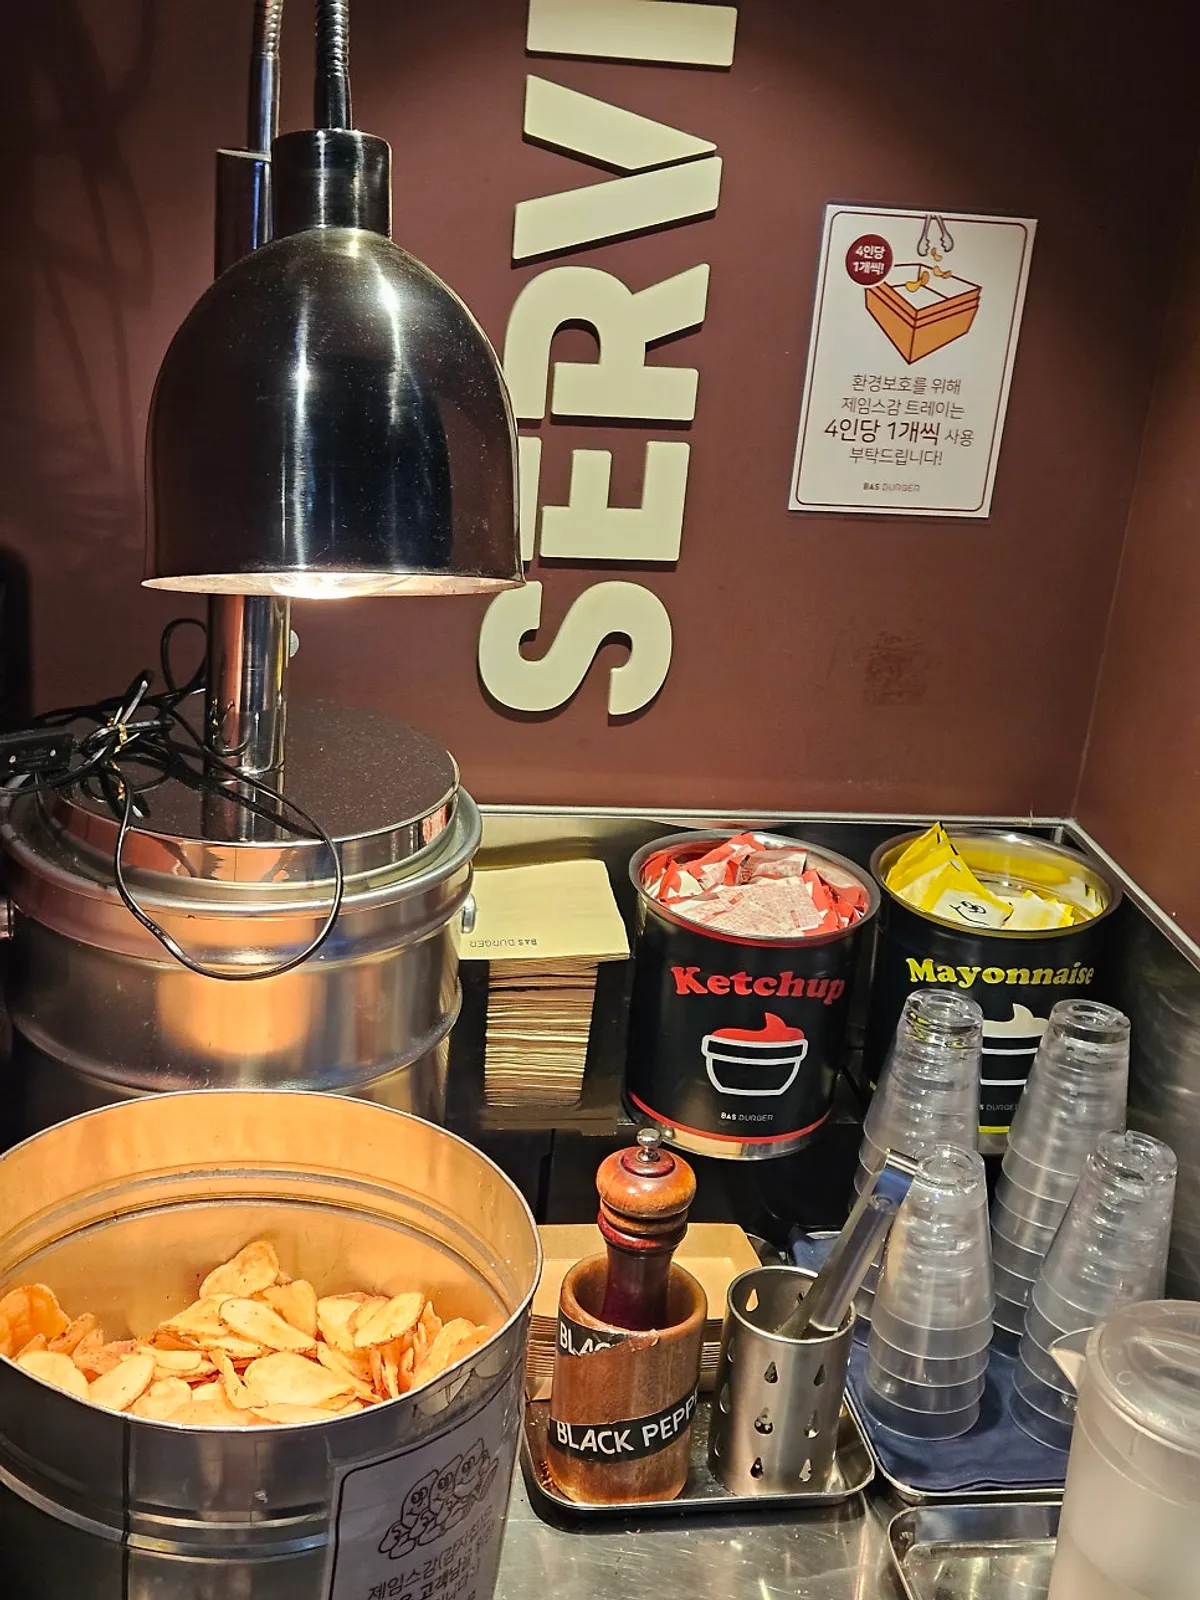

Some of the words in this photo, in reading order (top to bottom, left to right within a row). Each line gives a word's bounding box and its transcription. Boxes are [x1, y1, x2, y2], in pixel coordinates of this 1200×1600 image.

[855, 245, 886, 260] 4인당
[853, 261, 885, 276] 1개씩!
[479, 0, 738, 715] SERVI
[852, 374, 927, 395] 환경보호를
[931, 378, 962, 395] 위해
[841, 397, 902, 416] 제임스감
[904, 400, 965, 420] 트레이는
[824, 418, 881, 443] 4인당
[887, 421, 941, 446] 1개씩
[944, 429, 974, 447] 사용
[849, 447, 943, 466] 부탁드립니다!
[905, 957, 1095, 988] Mayonnaise
[670, 966, 845, 1005] Ketchup
[720, 1111, 737, 1120] BAS
[556, 1420, 634, 1455] BLACK
